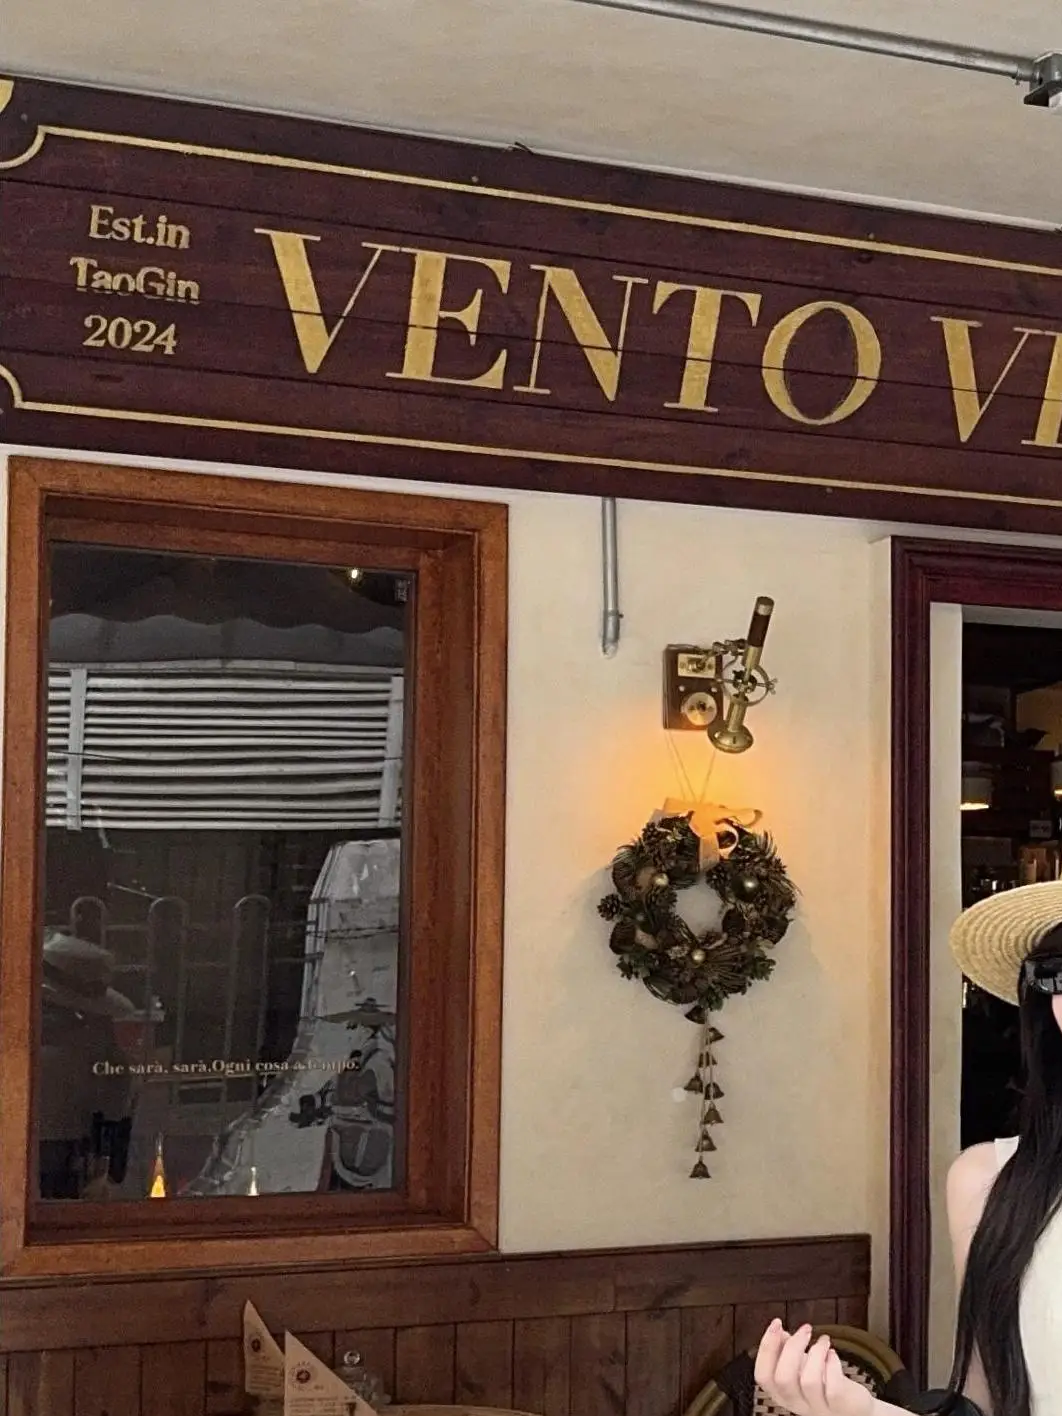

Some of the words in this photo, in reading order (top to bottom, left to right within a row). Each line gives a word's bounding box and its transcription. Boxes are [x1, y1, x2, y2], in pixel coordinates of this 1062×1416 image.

[89, 204, 190, 249] Est.in
[69, 256, 200, 305] TaoGin
[82, 314, 178, 355] 2024
[254, 228, 882, 425] VENTO
[92, 1060, 125, 1075] Che
[254, 1061, 289, 1071] cosa
